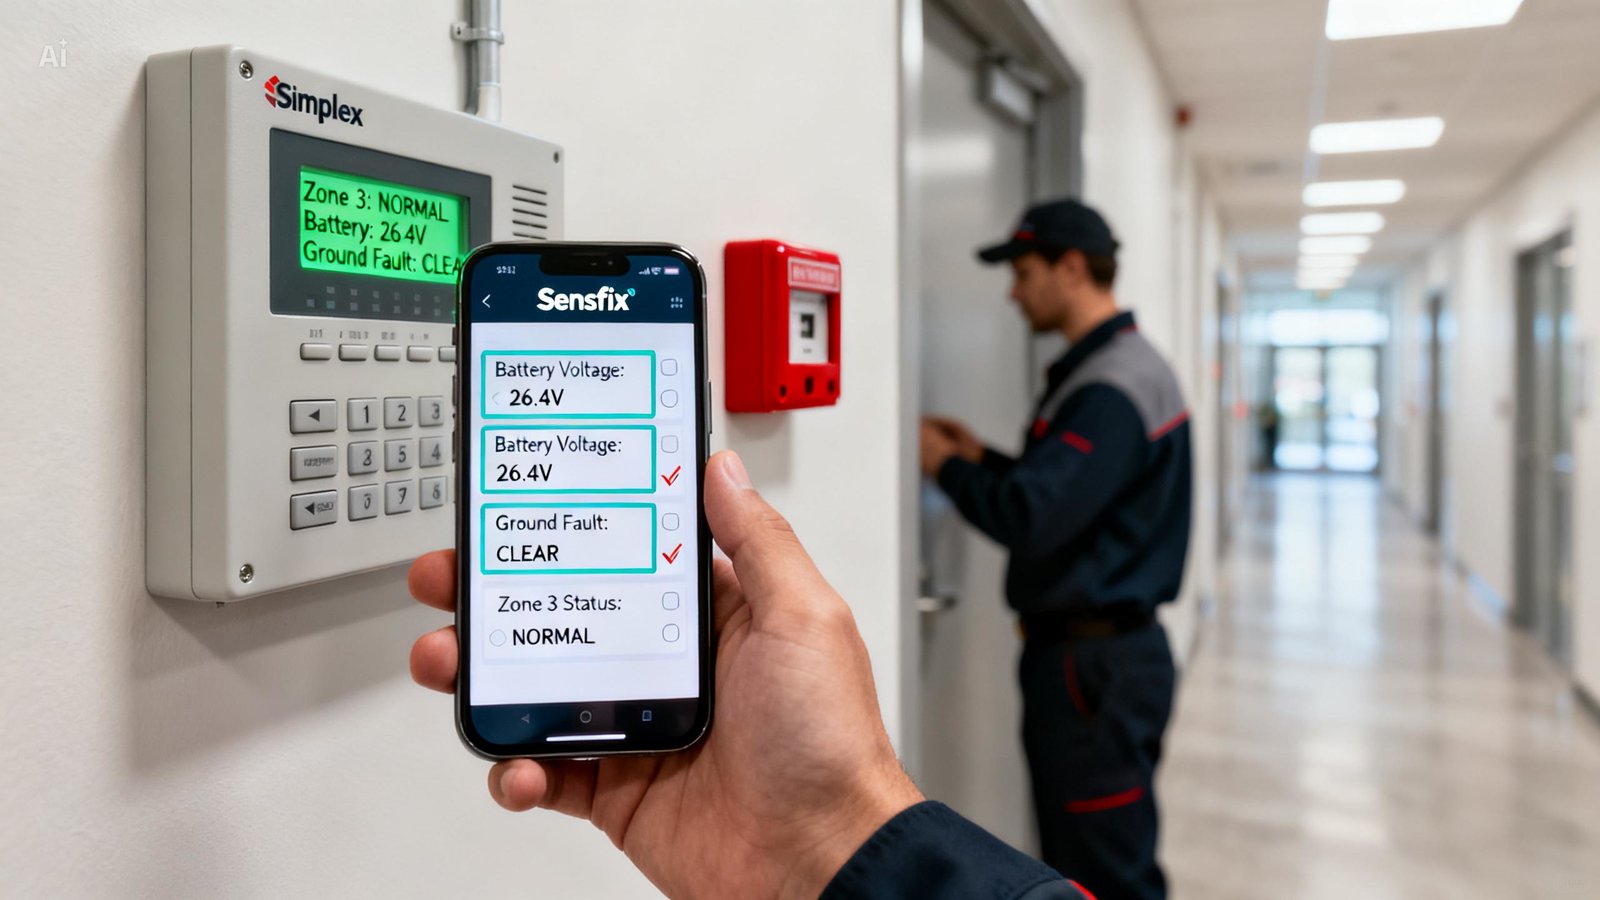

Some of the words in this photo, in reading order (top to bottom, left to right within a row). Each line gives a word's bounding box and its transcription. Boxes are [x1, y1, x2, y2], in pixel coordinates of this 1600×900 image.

[276, 82, 363, 127] Simplex
[303, 180, 349, 206] Zone
[356, 188, 371, 210] 3:
[378, 192, 449, 222] NORMAL
[304, 210, 373, 244] Battery:
[303, 240, 367, 267] Ground
[373, 248, 416, 272] Fault:
[536, 285, 630, 312] Sensfix
[495, 361, 555, 381] Battery
[559, 360, 625, 381] Voltage:
[509, 389, 564, 406] 26.4V
[363, 405, 369, 424] 1
[397, 404, 407, 422] 2
[495, 436, 553, 456] Battery
[557, 435, 622, 457] Voltage:
[496, 464, 553, 482] 26.4V
[496, 513, 557, 531] Ground
[563, 514, 608, 531] Fault:
[496, 545, 559, 562] CLEAR
[498, 596, 542, 612] Zone
[547, 595, 557, 611] 3
[563, 594, 622, 611] Status:
[512, 628, 595, 646] NORMAL
